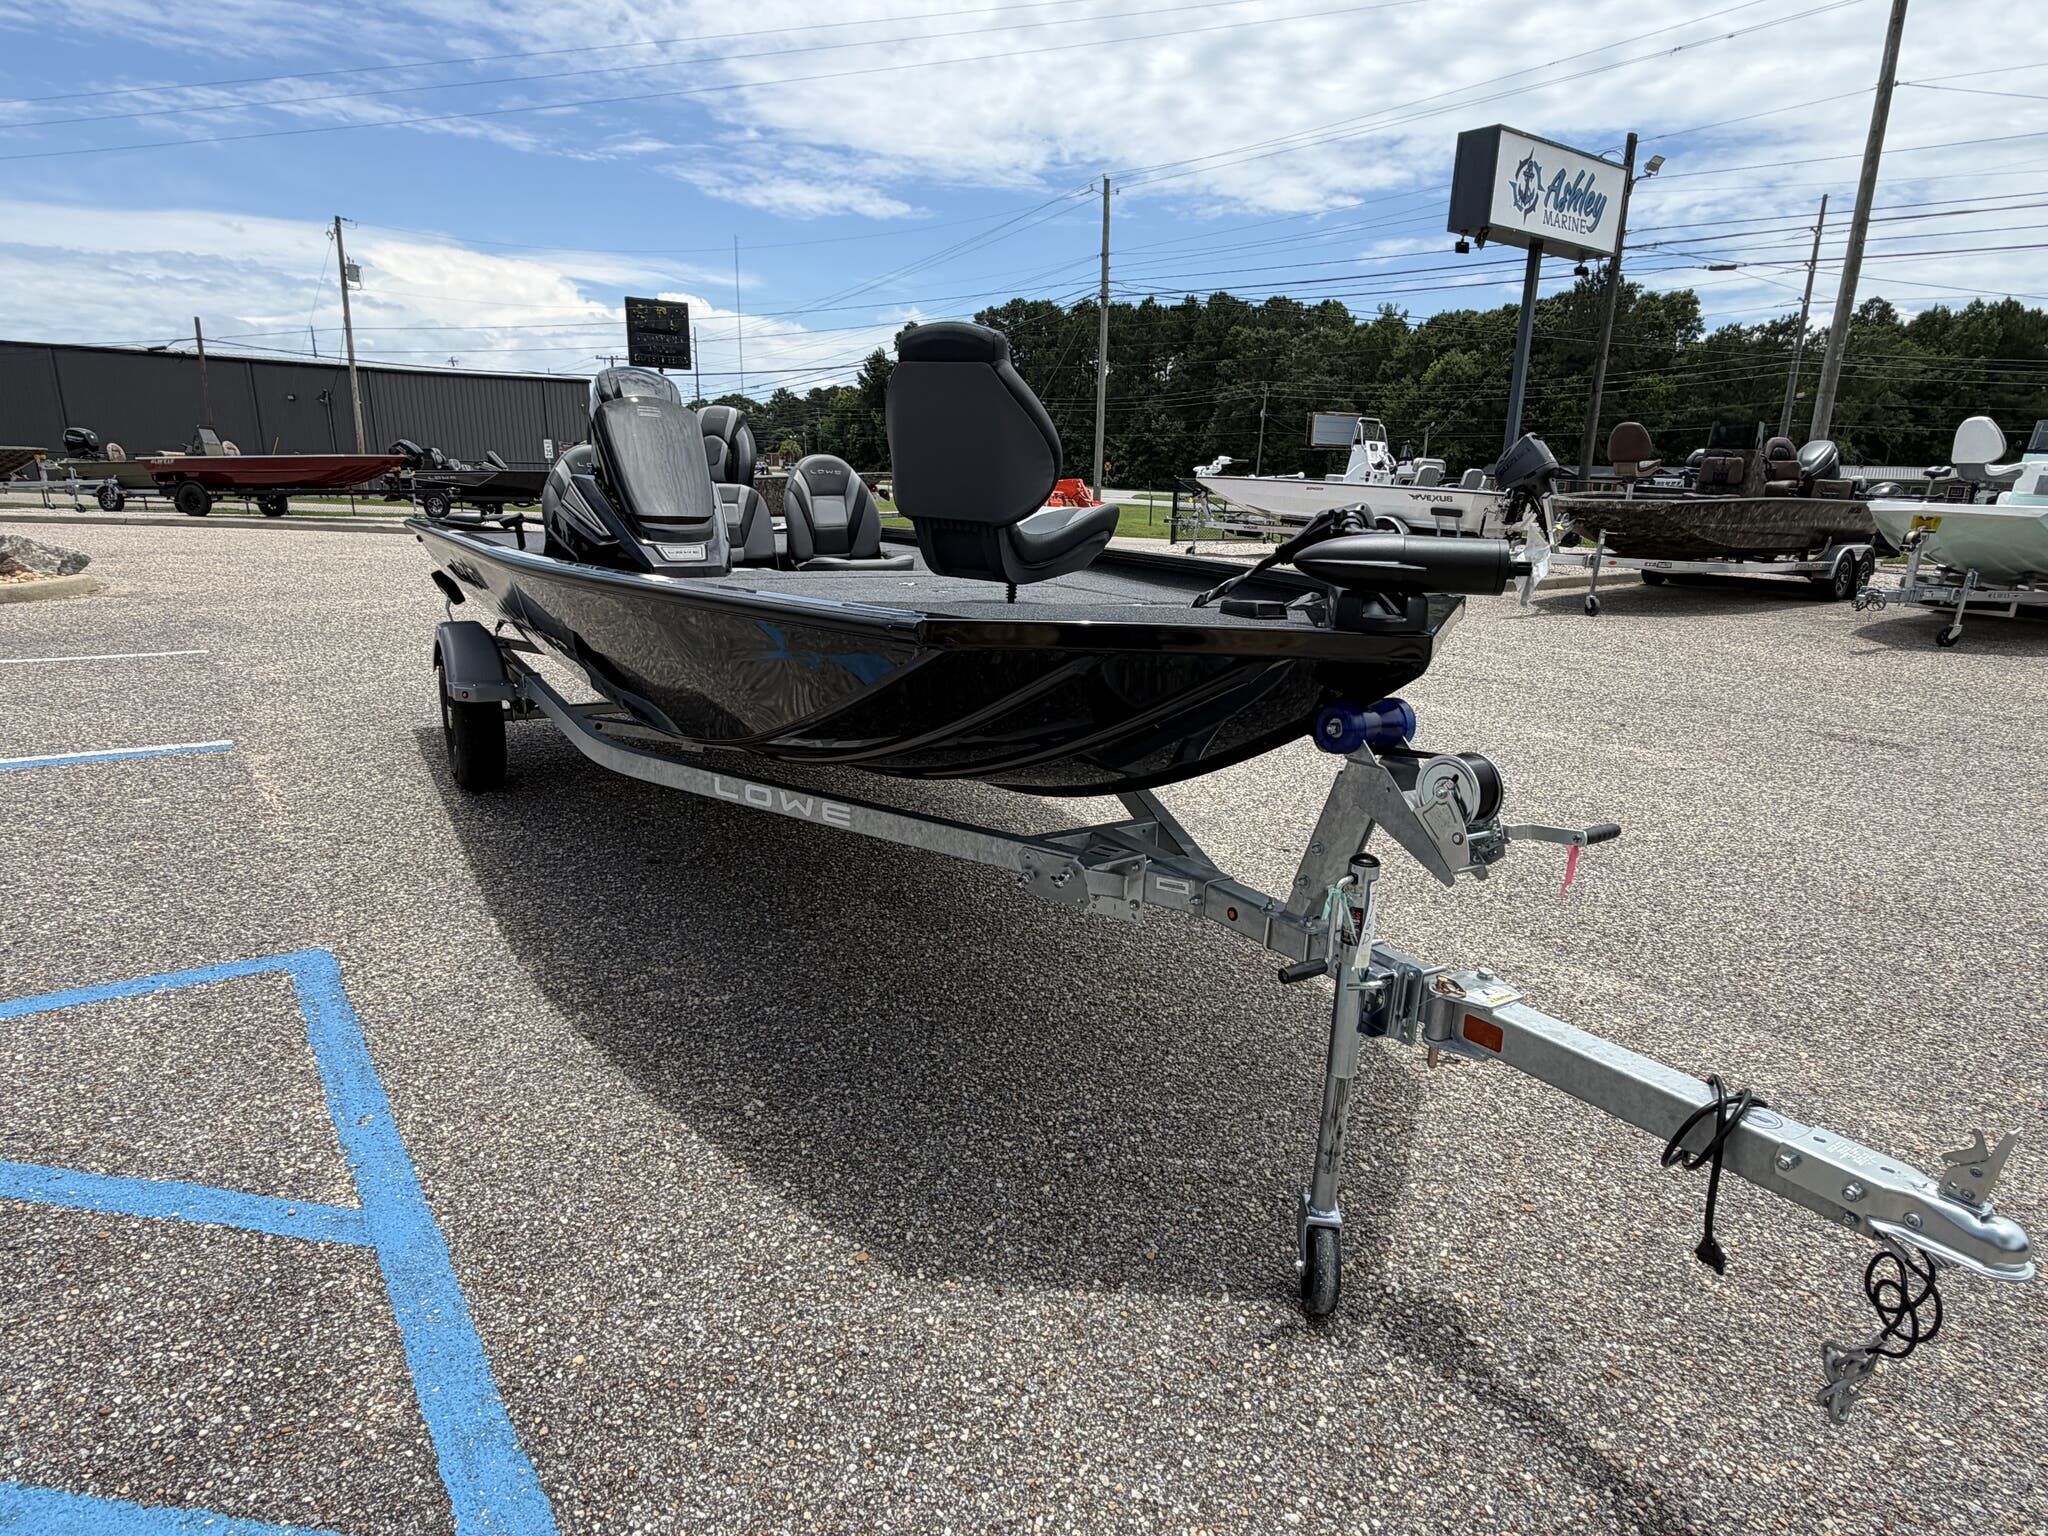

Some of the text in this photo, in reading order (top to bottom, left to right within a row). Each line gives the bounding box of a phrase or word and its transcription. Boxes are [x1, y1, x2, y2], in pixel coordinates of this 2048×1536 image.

[1543, 168, 1608, 233] Ashley
[1543, 209, 1587, 235] MARINE
[1420, 494, 1454, 503] VEXUS
[714, 776, 851, 827] LOWE
